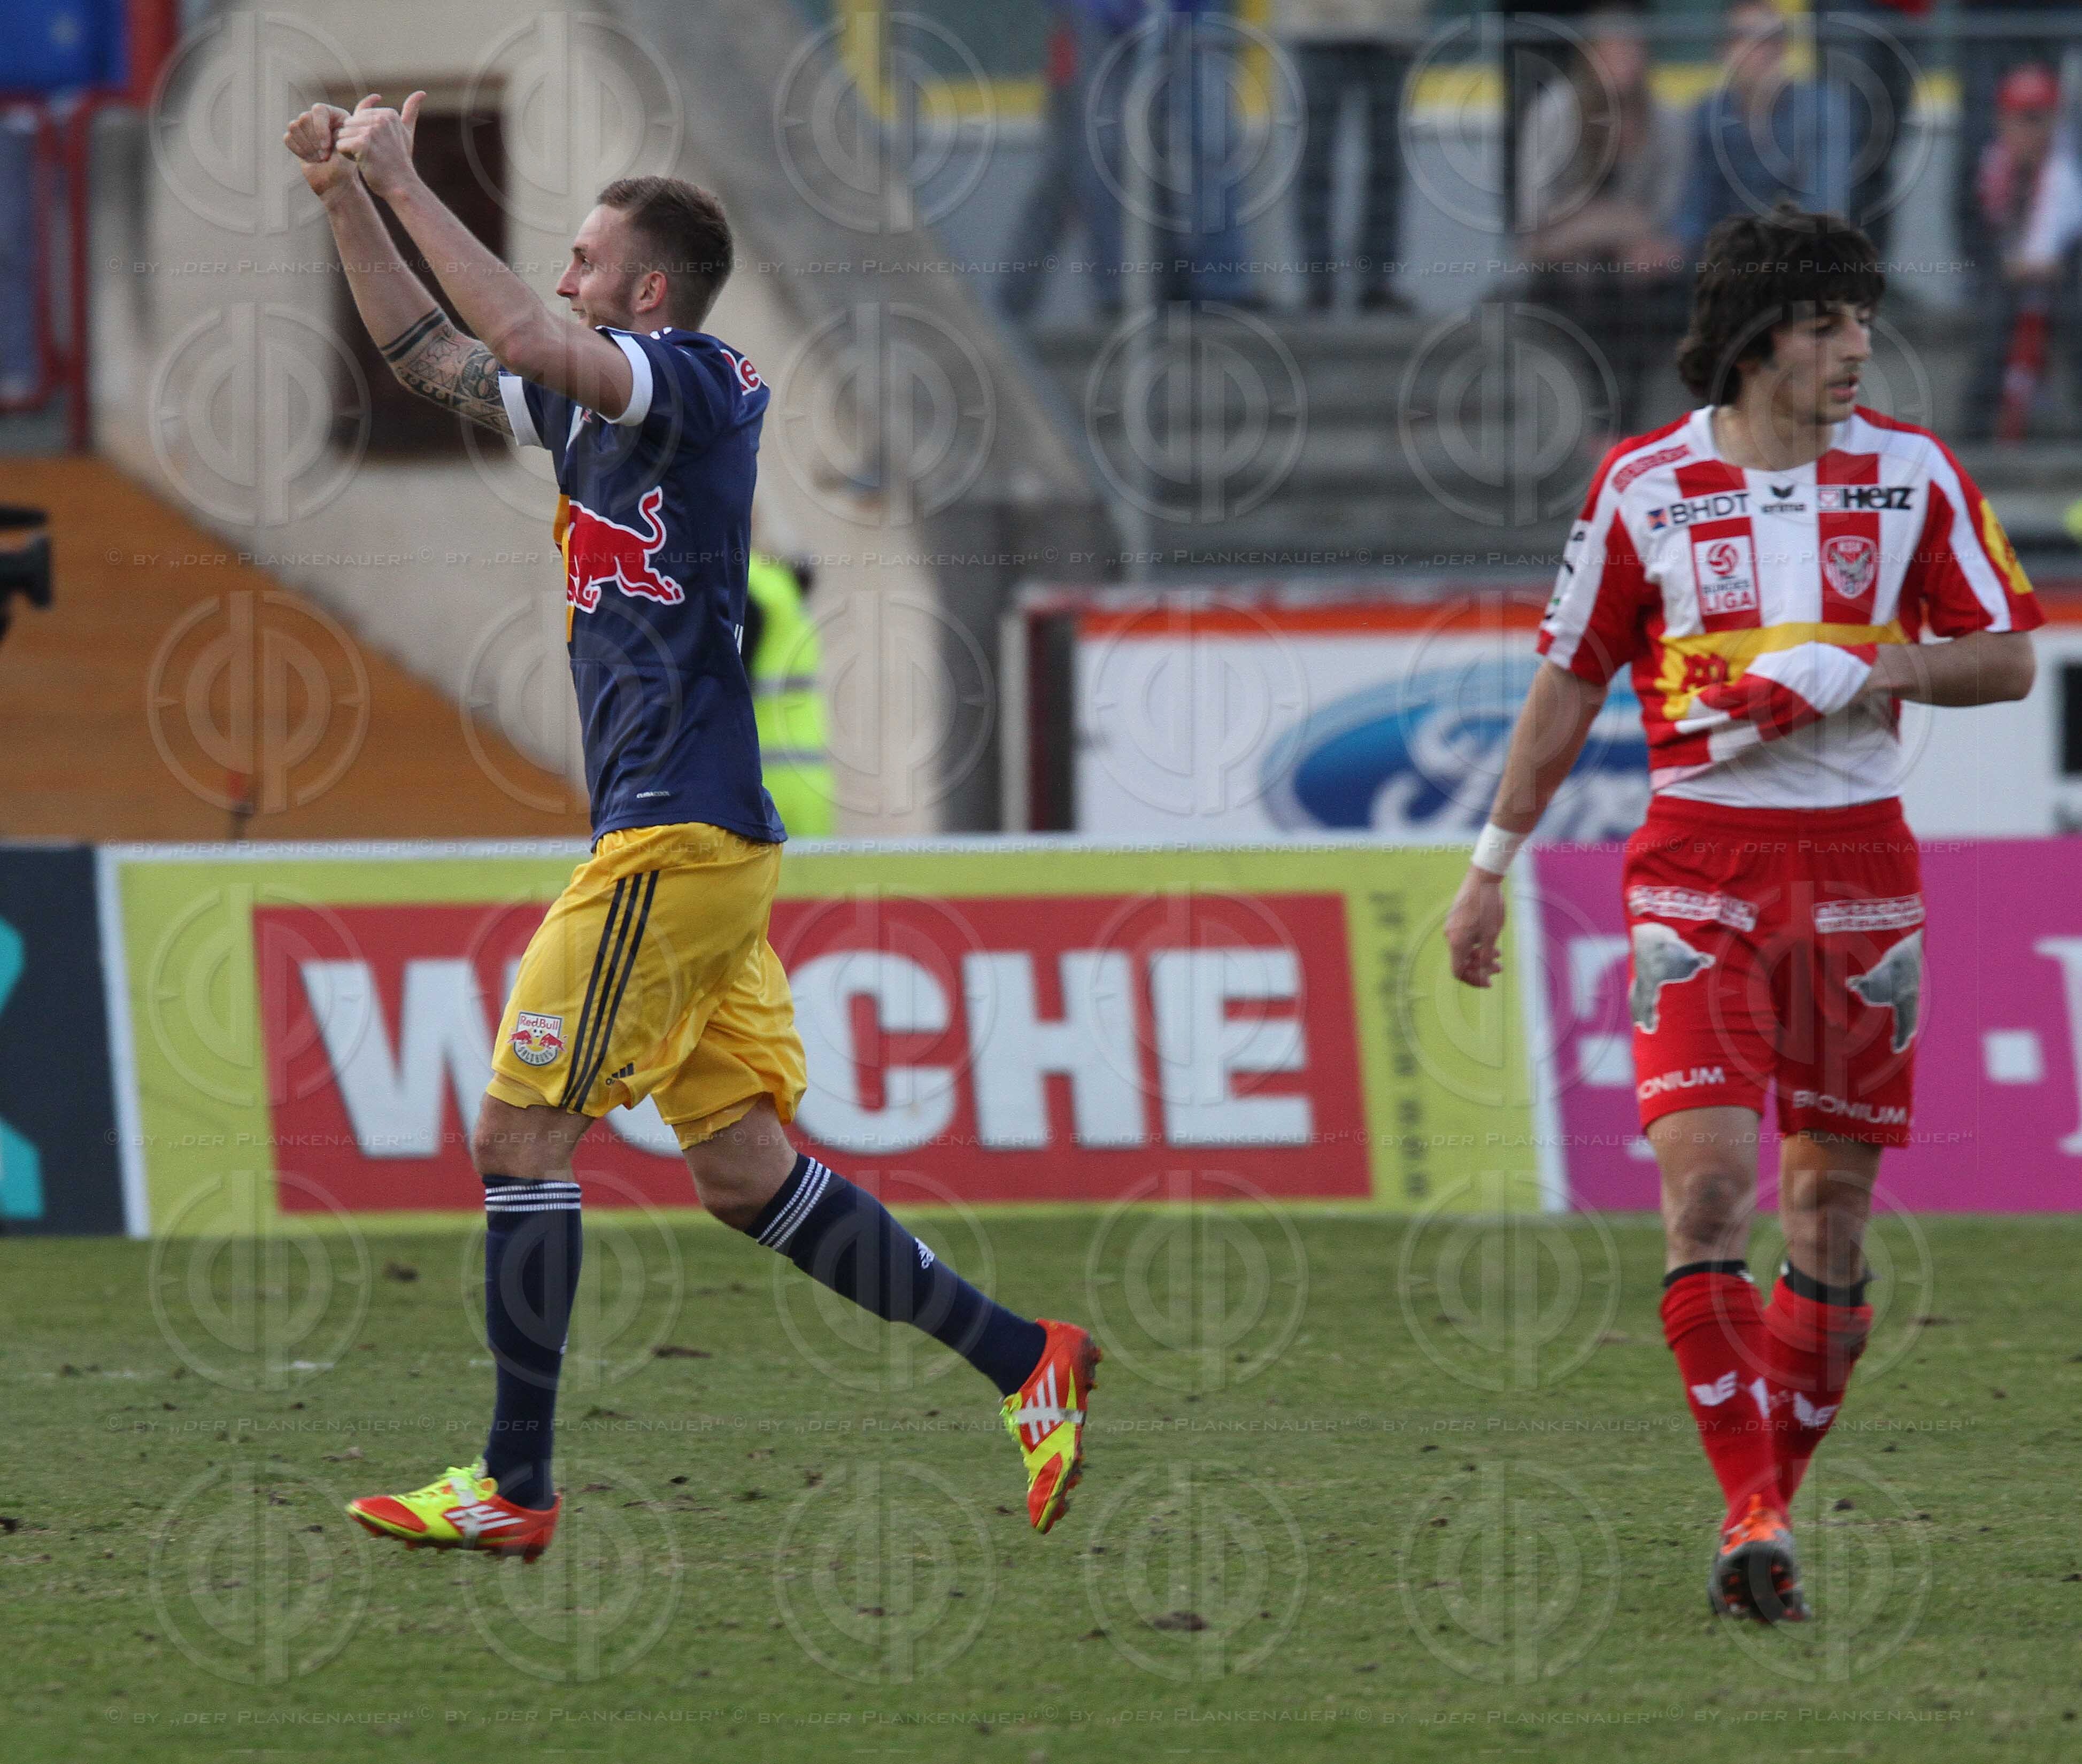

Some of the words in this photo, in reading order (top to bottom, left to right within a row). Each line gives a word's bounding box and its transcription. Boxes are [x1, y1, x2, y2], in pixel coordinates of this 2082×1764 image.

[1670, 492, 1749, 524] BHDT
[1701, 590, 1753, 614] LIGA
[300, 947, 1314, 1161] WCHE
[1793, 1089, 1907, 1124] BIONIUM
